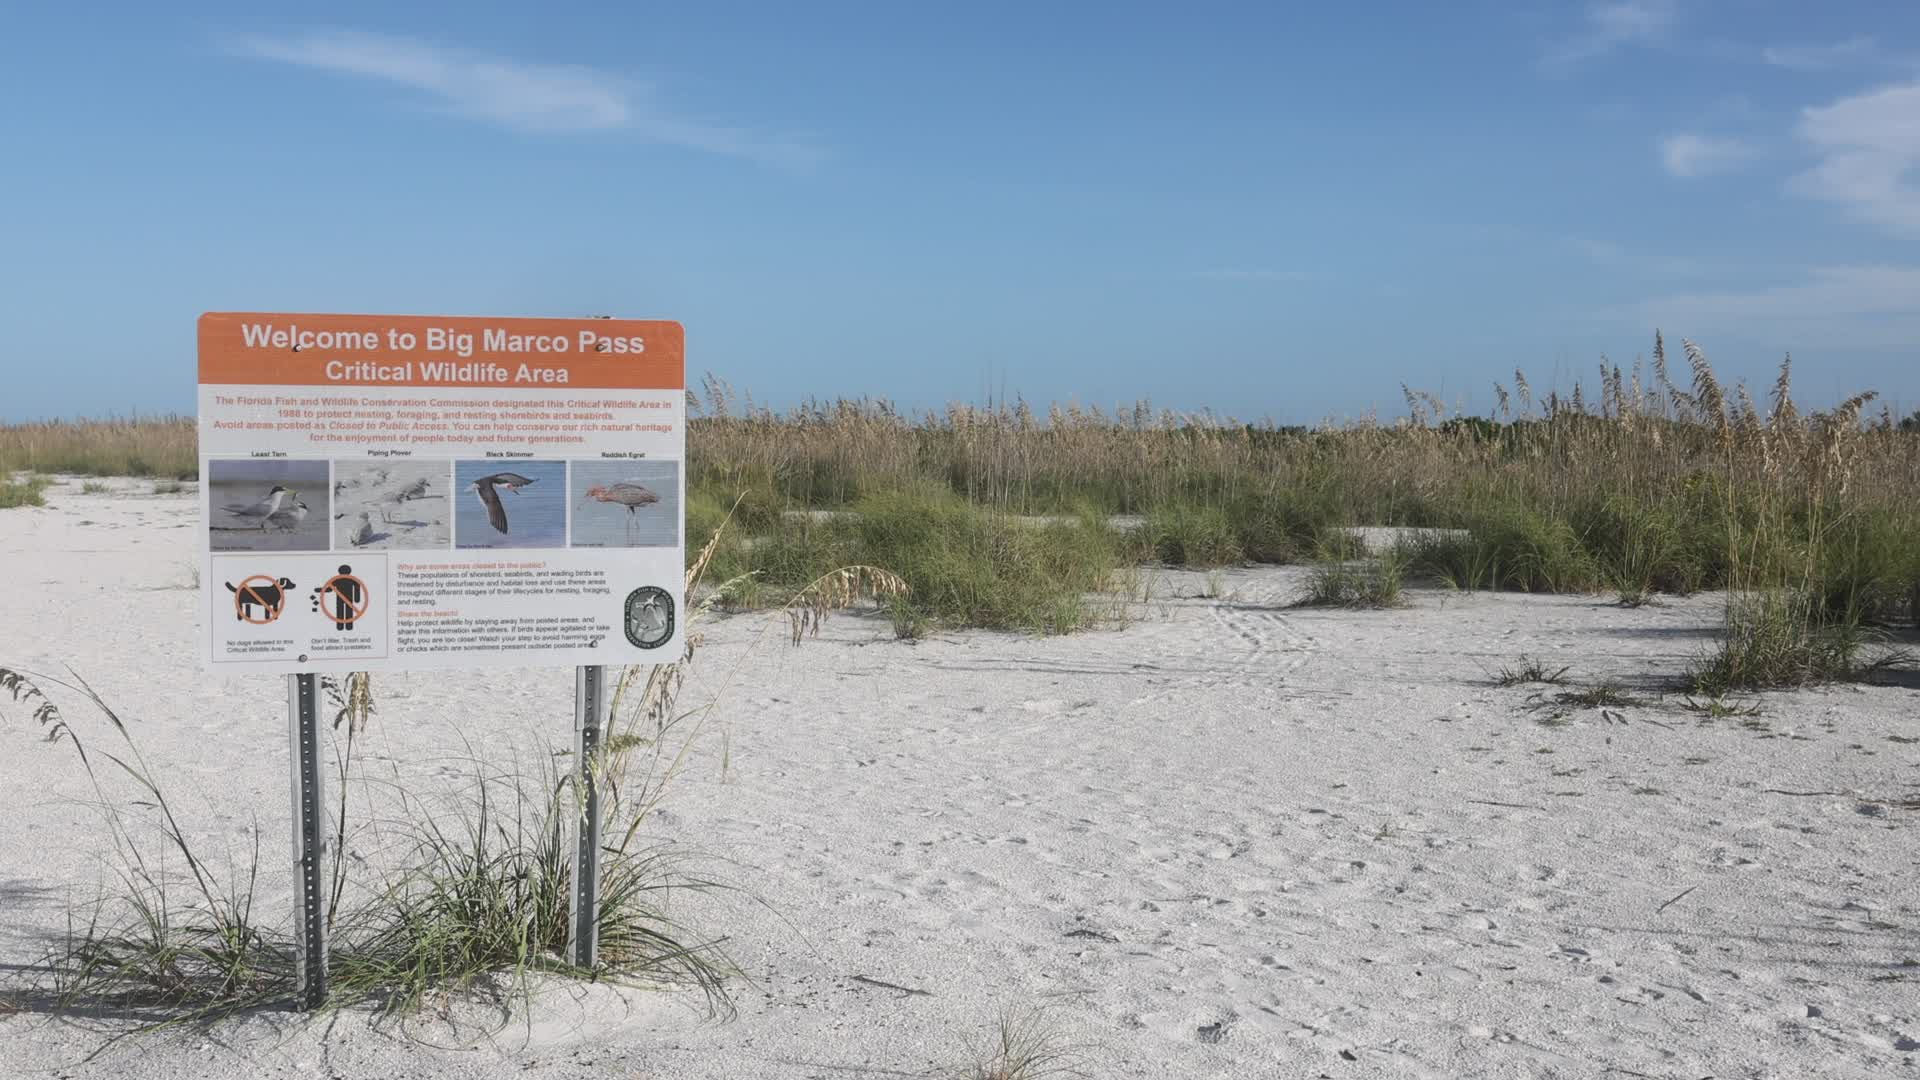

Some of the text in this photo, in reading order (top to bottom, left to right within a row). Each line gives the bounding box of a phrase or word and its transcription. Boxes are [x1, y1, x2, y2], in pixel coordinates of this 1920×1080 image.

[242, 325, 644, 356] Welcome to Big Marco Pass
[326, 361, 568, 382] Critical Wildlife Area
[216, 396, 671, 410] The Florida Fish and Wildlife Conservation Commission designated this Critical Wildlife Area in
[278, 409, 301, 418] 1988
[316, 410, 352, 420] protect
[354, 410, 394, 420] nesting,
[396, 410, 440, 420] foraging,
[442, 411, 461, 419] and
[464, 411, 496, 421] resting
[500, 411, 550, 419] shorebirds
[553, 411, 571, 419] and
[573, 412, 613, 420] seabirds.
[213, 421, 244, 429] Avoid
[277, 421, 313, 432] posted
[329, 422, 364, 430] Closed
[379, 422, 409, 430] Public
[412, 422, 450, 430] Access.
[453, 422, 470, 430] You
[493, 422, 514, 433] help
[580, 423, 598, 431] rich
[601, 423, 633, 431] natural
[636, 423, 672, 433] heritage
[310, 433, 325, 441] for
[326, 433, 342, 442] the
[344, 434, 396, 444] enjoyment
[399, 434, 409, 442] of
[412, 434, 444, 444] people
[447, 434, 474, 444] today
[528, 435, 584, 444] generations.
